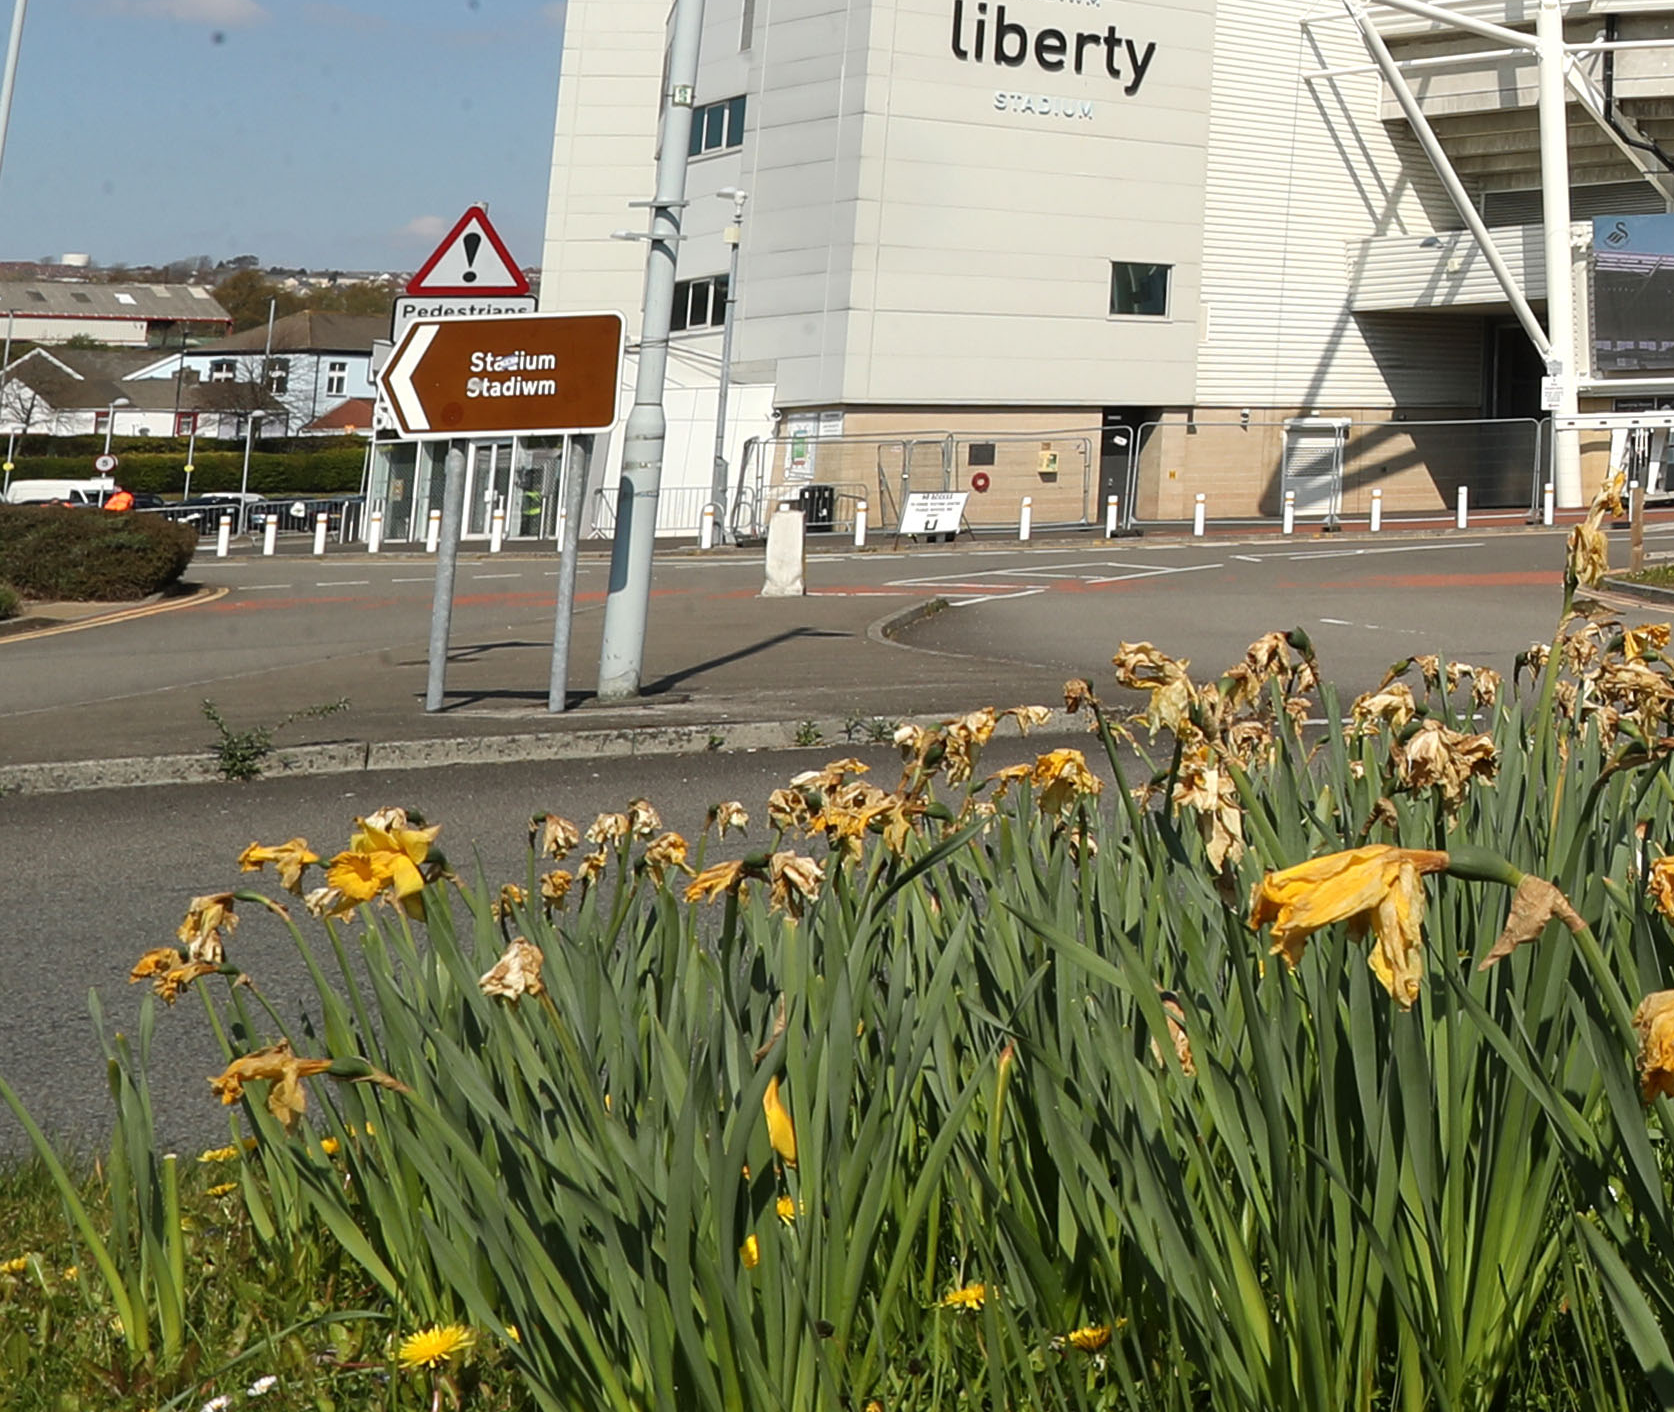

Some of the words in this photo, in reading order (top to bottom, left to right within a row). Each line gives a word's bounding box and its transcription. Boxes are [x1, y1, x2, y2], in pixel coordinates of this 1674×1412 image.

[993, 92, 1094, 121] STADIUM
[403, 305, 527, 318] Pedestrians
[466, 376, 556, 398] Stadiwm
